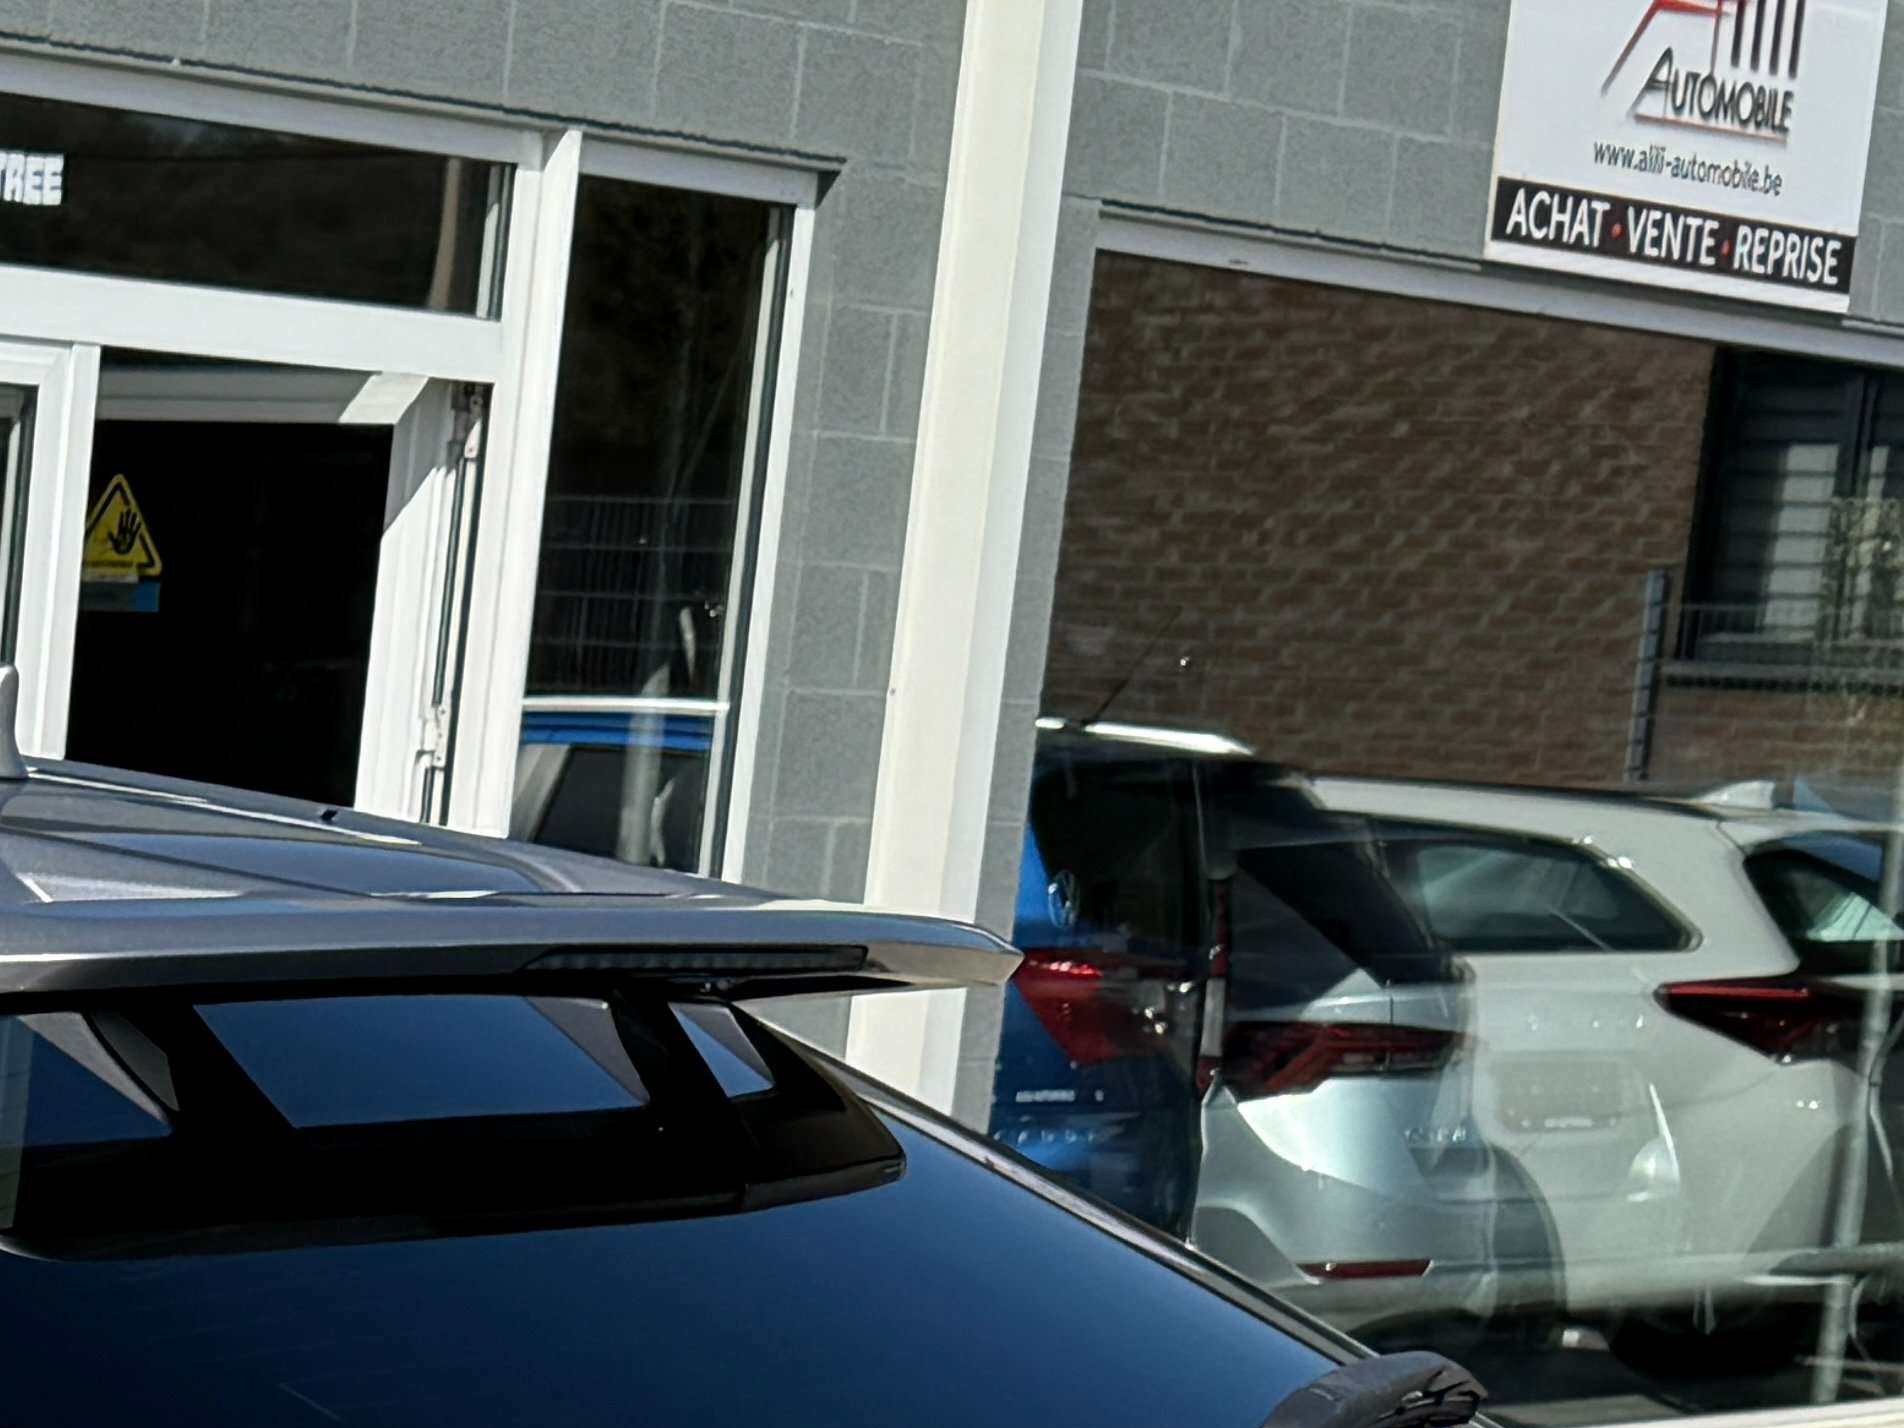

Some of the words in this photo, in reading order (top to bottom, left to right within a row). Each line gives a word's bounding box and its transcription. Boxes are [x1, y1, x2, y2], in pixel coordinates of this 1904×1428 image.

[1505, 187, 1610, 248] ACHAT
[1625, 205, 1719, 267] VENTE
[1732, 224, 1842, 286] REPRISE
